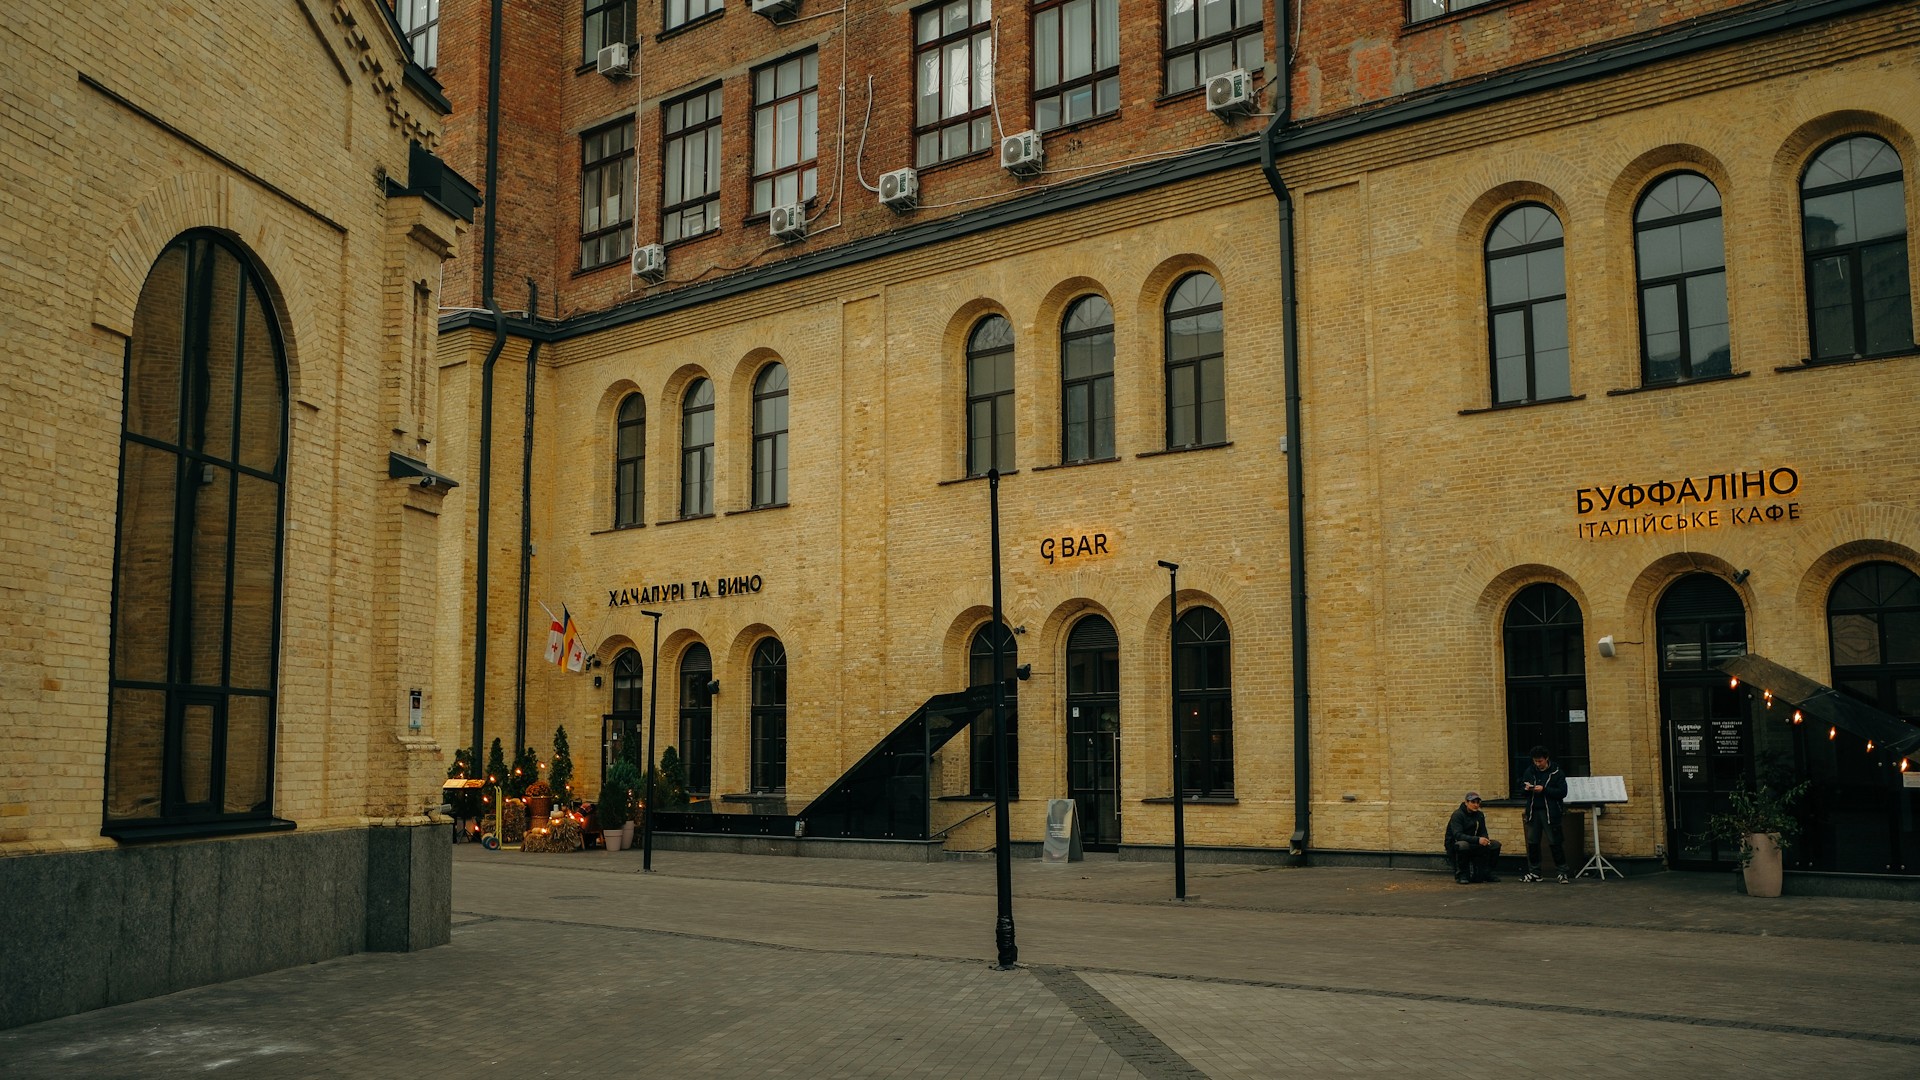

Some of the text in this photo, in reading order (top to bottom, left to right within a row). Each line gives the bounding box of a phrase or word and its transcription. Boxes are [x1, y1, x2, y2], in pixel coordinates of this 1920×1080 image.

[1576, 467, 1798, 514] БУФФАЛІНО
[1578, 502, 1800, 538] ІТАЛІЙСЬКЕ КАФЕ
[1061, 533, 1109, 558] BAR
[608, 574, 762, 607] ХАЧАПУРІ ТА ВИНО
